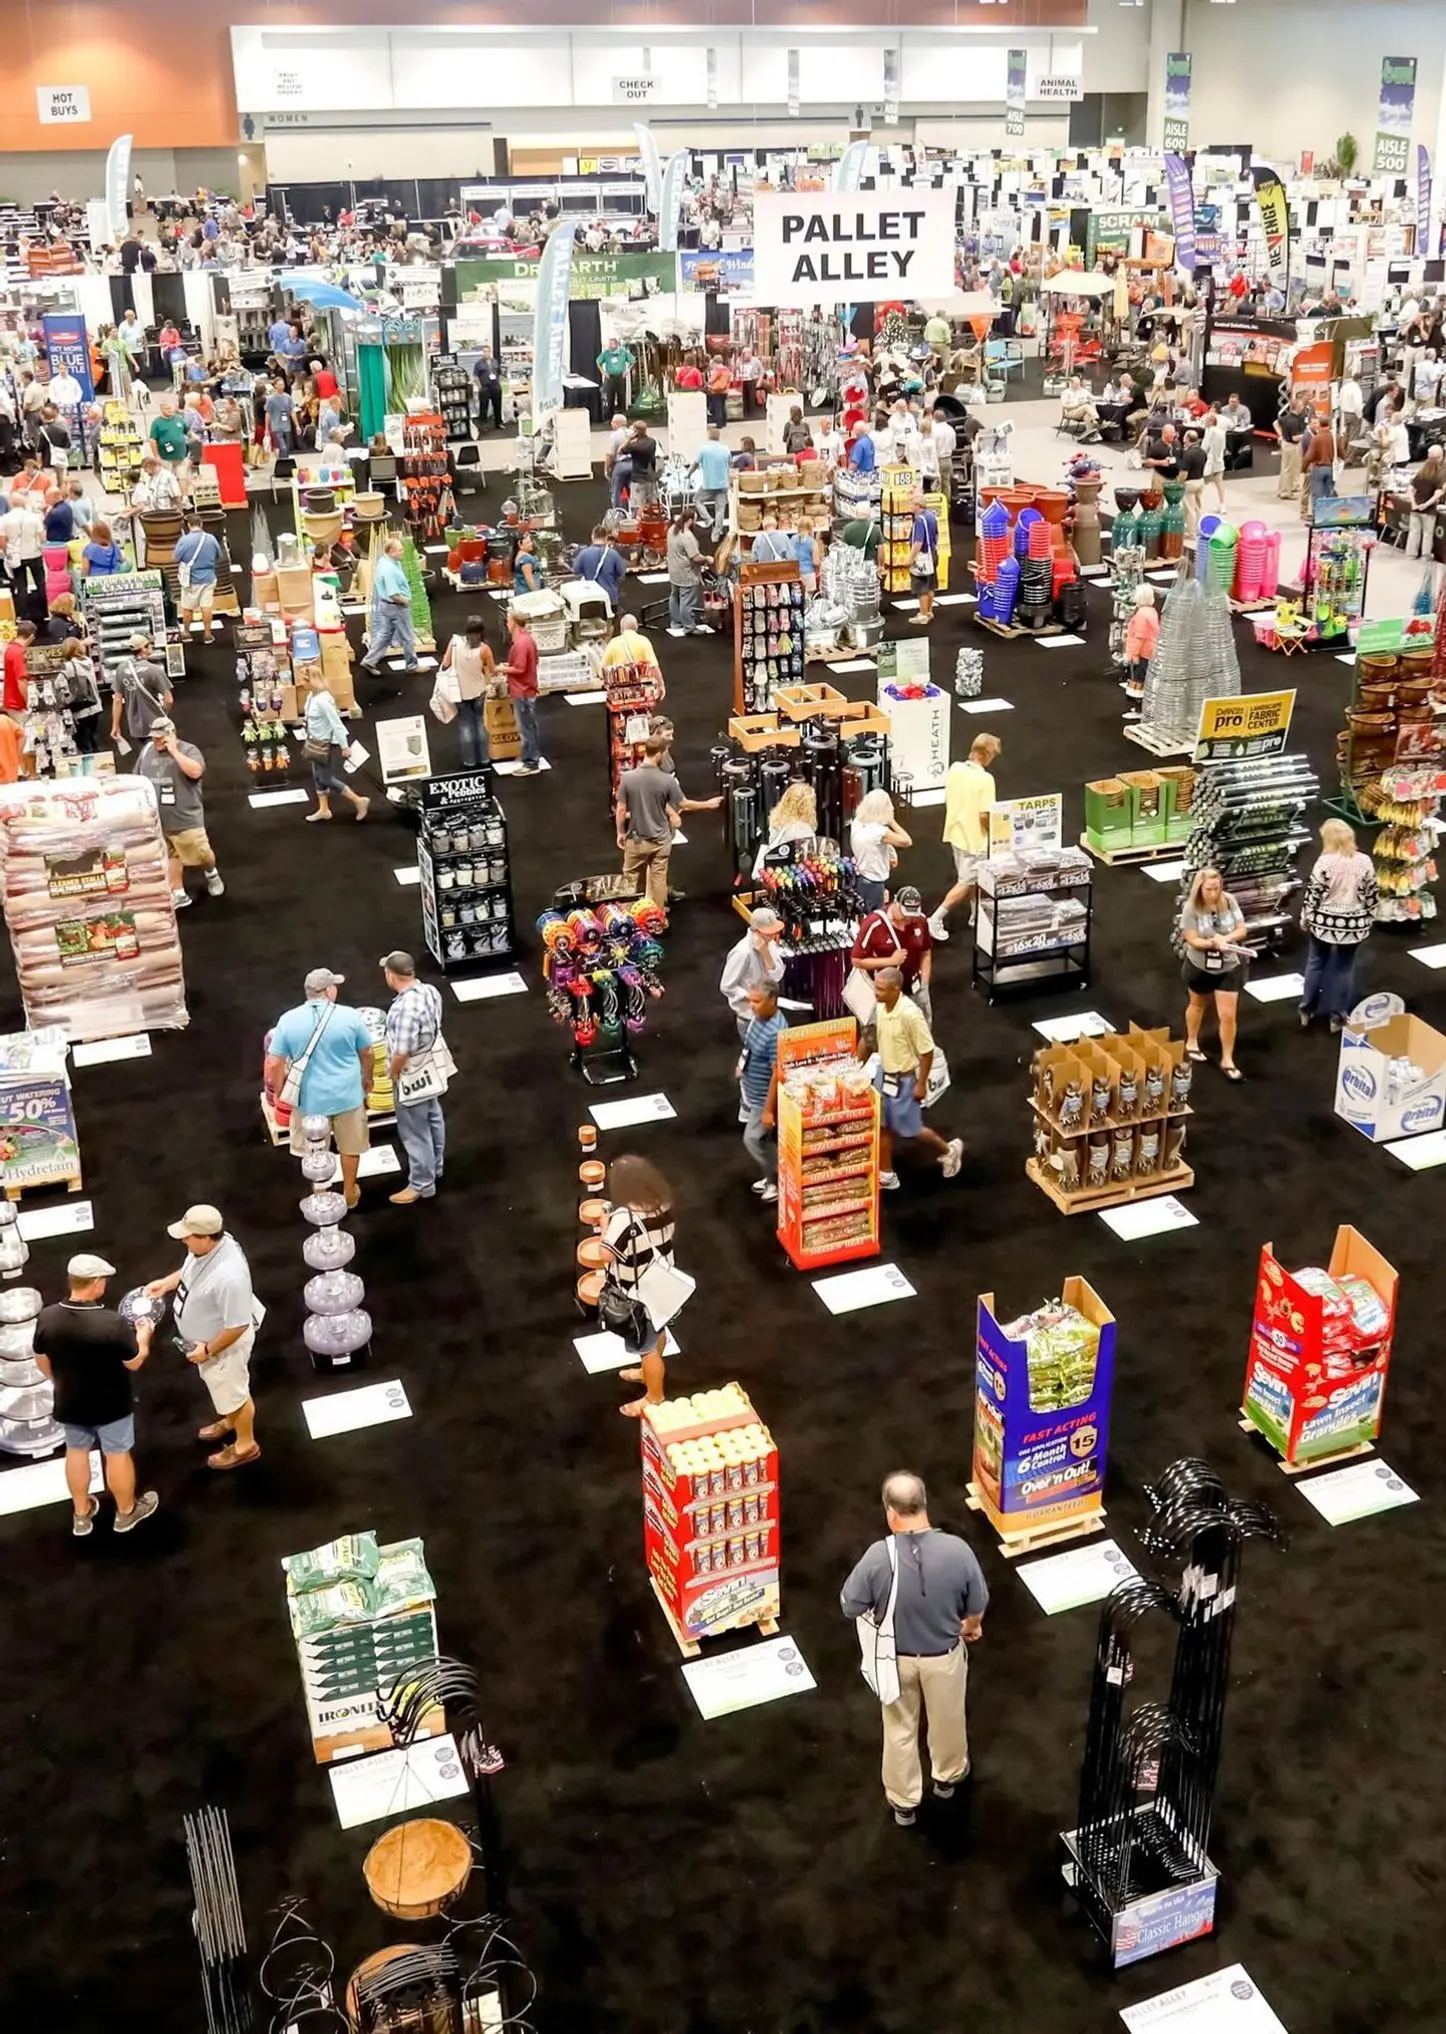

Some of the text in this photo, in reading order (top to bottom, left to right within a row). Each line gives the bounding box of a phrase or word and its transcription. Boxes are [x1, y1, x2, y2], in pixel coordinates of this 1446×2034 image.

[619, 80, 654, 89] CHECK
[1040, 79, 1078, 88] ANIMAL
[52, 93, 72, 103] HOT
[626, 90, 648, 99] OUT
[1039, 88, 1078, 97] HEALTH
[51, 105, 78, 116] BUYS
[268, 114, 308, 122] WOMEN
[1007, 110, 1024, 123] AISLE
[1006, 122, 1023, 134] 700
[1165, 122, 1188, 137] AISLE
[1164, 138, 1186, 150] 600
[1377, 139, 1408, 156] AISLE
[1376, 155, 1406, 171] 500
[781, 211, 926, 244] PALLET
[1098, 213, 1160, 229] SCRAM
[568, 259, 618, 274] ARTH
[791, 250, 915, 283] ALLEY
[50, 354, 86, 366] BLUE
[1248, 708, 1280, 721] FABRIC
[1214, 715, 1243, 732] pro
[1247, 717, 1280, 730] CENTER
[931, 709, 940, 760] HEATH
[1261, 736, 1282, 752] pro
[428, 776, 485, 795] EXOTIC
[448, 786, 486, 799] Pebbles
[440, 796, 449, 805] &
[1018, 797, 1057, 812] TARPS
[402, 1069, 433, 1096] bwi
[15, 1087, 61, 1101] WATERING
[8, 1096, 57, 1124] 50%
[7, 1159, 75, 1182] Hydretain
[1327, 1370, 1379, 1410] Sevin
[1302, 1394, 1367, 1431] Lawn Insect
[1023, 1411, 1097, 1444] FAST ACTING
[1300, 1410, 1359, 1444] Granules
[1018, 1435, 1068, 1456] ONE APPLICATION
[1072, 1434, 1095, 1450] 15
[1017, 1443, 1067, 1474] 6 Month
[1031, 1453, 1067, 1470] Control
[1021, 1476, 1051, 1496] Over
[1066, 1459, 1092, 1481] Out!
[1026, 1500, 1086, 1521] GUARANTEED
[701, 1576, 747, 1607] Sevin
[1137, 1906, 1214, 1945] Classic Hangers
